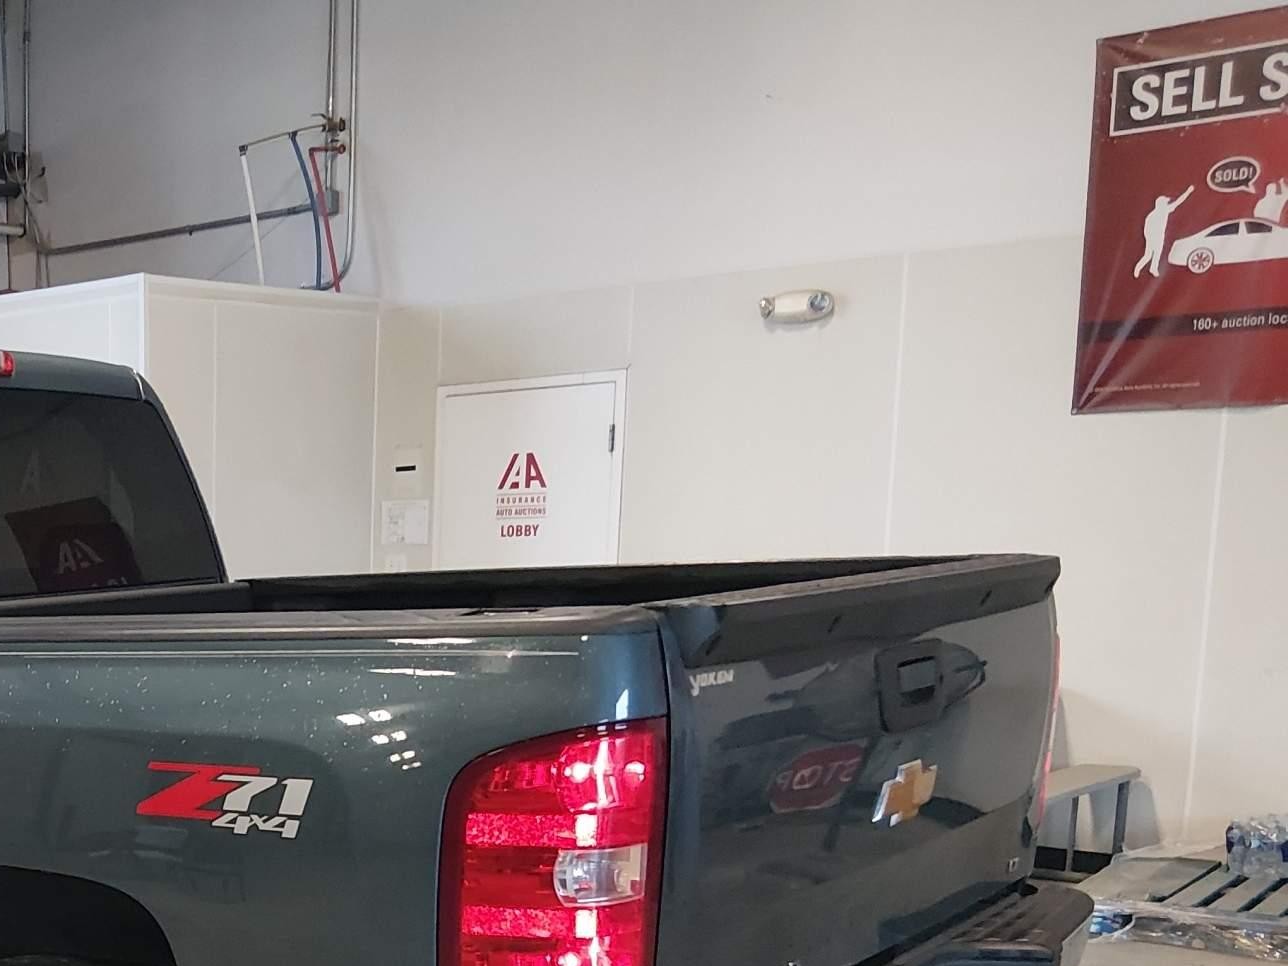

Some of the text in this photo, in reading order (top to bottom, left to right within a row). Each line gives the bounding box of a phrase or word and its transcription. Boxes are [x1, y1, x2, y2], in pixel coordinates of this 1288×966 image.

[1129, 60, 1245, 121] SELL
[1214, 166, 1253, 184] SOLD!
[1192, 316, 1218, 331] 160+
[1221, 313, 1265, 329] auction
[496, 495, 547, 505] INSURANCE
[496, 506, 546, 517] AUTO AUCTIONS
[500, 523, 540, 538] LOBBY
[136, 760, 314, 821] Z71
